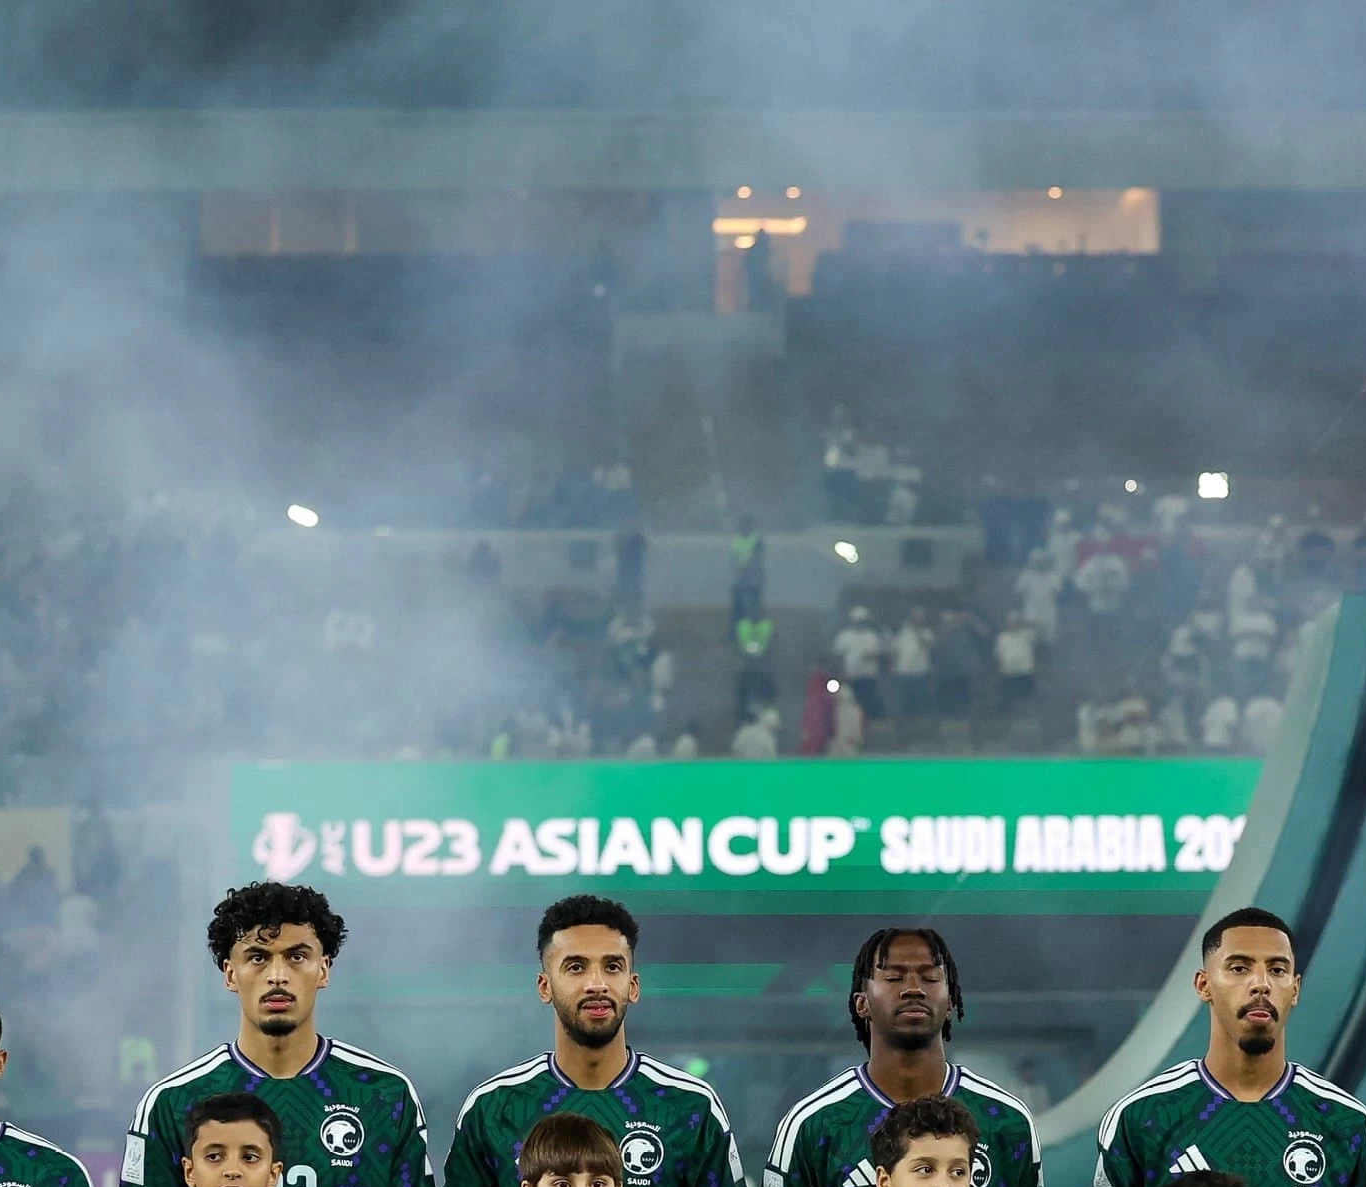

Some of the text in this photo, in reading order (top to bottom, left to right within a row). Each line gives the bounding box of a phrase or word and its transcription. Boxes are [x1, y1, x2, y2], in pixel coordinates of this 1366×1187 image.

[350, 818, 481, 877] U23
[489, 816, 704, 877] ASIAN
[880, 815, 1006, 874] SAUDI
[1013, 815, 1167, 873] ARABIA
[1175, 815, 1247, 873] 20
[330, 1159, 353, 1167] SAUDI
[626, 1177, 651, 1186] SAUDI
